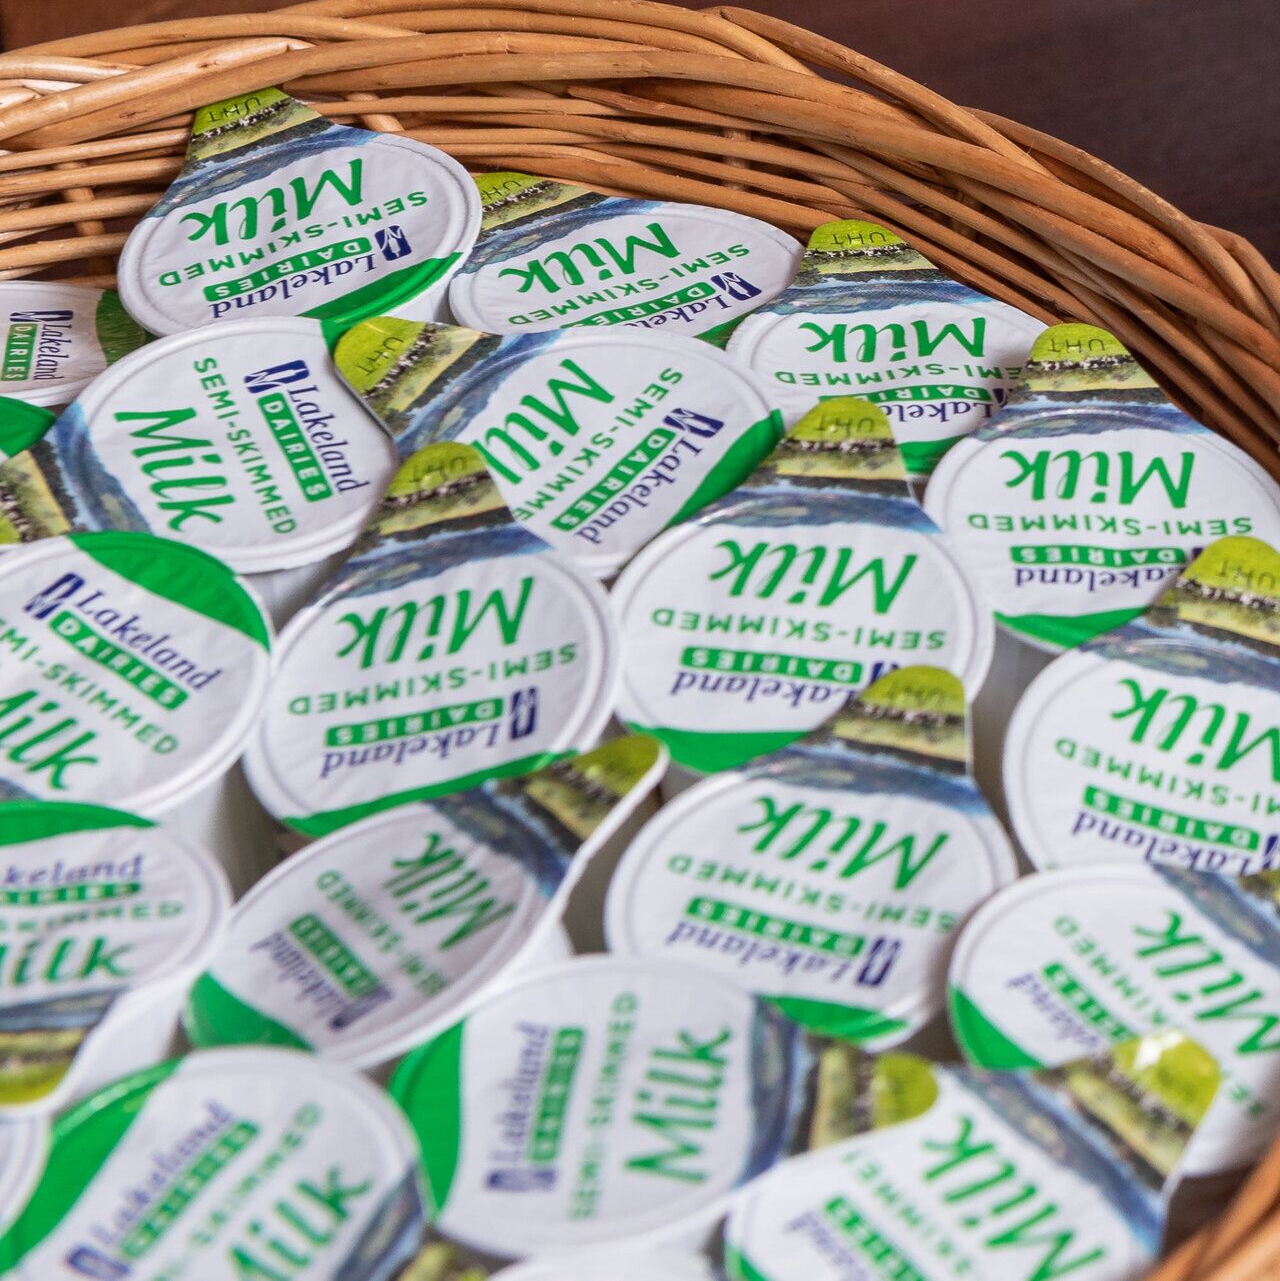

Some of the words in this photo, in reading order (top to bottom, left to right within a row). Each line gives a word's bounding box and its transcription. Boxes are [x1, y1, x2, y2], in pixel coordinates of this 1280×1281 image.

[207, 96, 262, 124] UHT
[180, 158, 365, 247] Milk
[482, 179, 522, 201] UH
[158, 190, 429, 289] SEMI-SKIMMED
[212, 237, 361, 301] DAIRIES
[497, 221, 683, 295] Milk
[829, 229, 887, 248] UHT
[211, 252, 379, 318] Lakeland
[507, 243, 752, 327] SEMI-SKIMMED
[624, 294, 734, 329] Lake
[4, 325, 33, 378] DAIRIES
[33, 323, 73, 380] Lakeland
[800, 316, 988, 365] Milk
[1046, 334, 1108, 357] UHT
[775, 363, 1025, 387] EMI-SKIMMED
[857, 386, 982, 402] DAIRI
[286, 383, 371, 495] Lakeland
[879, 400, 994, 424] Lakel
[115, 406, 237, 534] Milk
[193, 356, 298, 536] SEMI-SKIMMED
[262, 398, 328, 500] DAIRIES
[515, 366, 685, 525] SEMI-SKIMME
[556, 431, 672, 532] DAIRIES
[573, 437, 704, 548] Lakeland
[1000, 450, 1197, 509] Milk
[967, 513, 1254, 537] SEMI-SKIMMED
[1019, 547, 1178, 566] DAIRIES
[709, 540, 918, 616] Milk
[75, 590, 224, 690] Lakeland
[336, 575, 535, 671] Milk
[651, 607, 949, 651] SEMI-SKIMMED
[0, 618, 181, 755] MI-SKIMMED
[56, 616, 183, 706] DAIRIES
[288, 642, 578, 717] SEMI-SKIMMED
[690, 648, 855, 683] DAIRIES
[319, 724, 503, 778] Lakeland
[331, 701, 501, 746] DAIRIES
[737, 795, 950, 891] Milk
[1089, 788, 1254, 848] DAIRIES
[4, 852, 144, 886] keland
[380, 831, 519, 952] Milk
[668, 852, 963, 935] SEMI-SKIMMED
[0, 936, 135, 986] ilk
[668, 921, 855, 984] Lakeland
[623, 1023, 732, 1185] Milk
